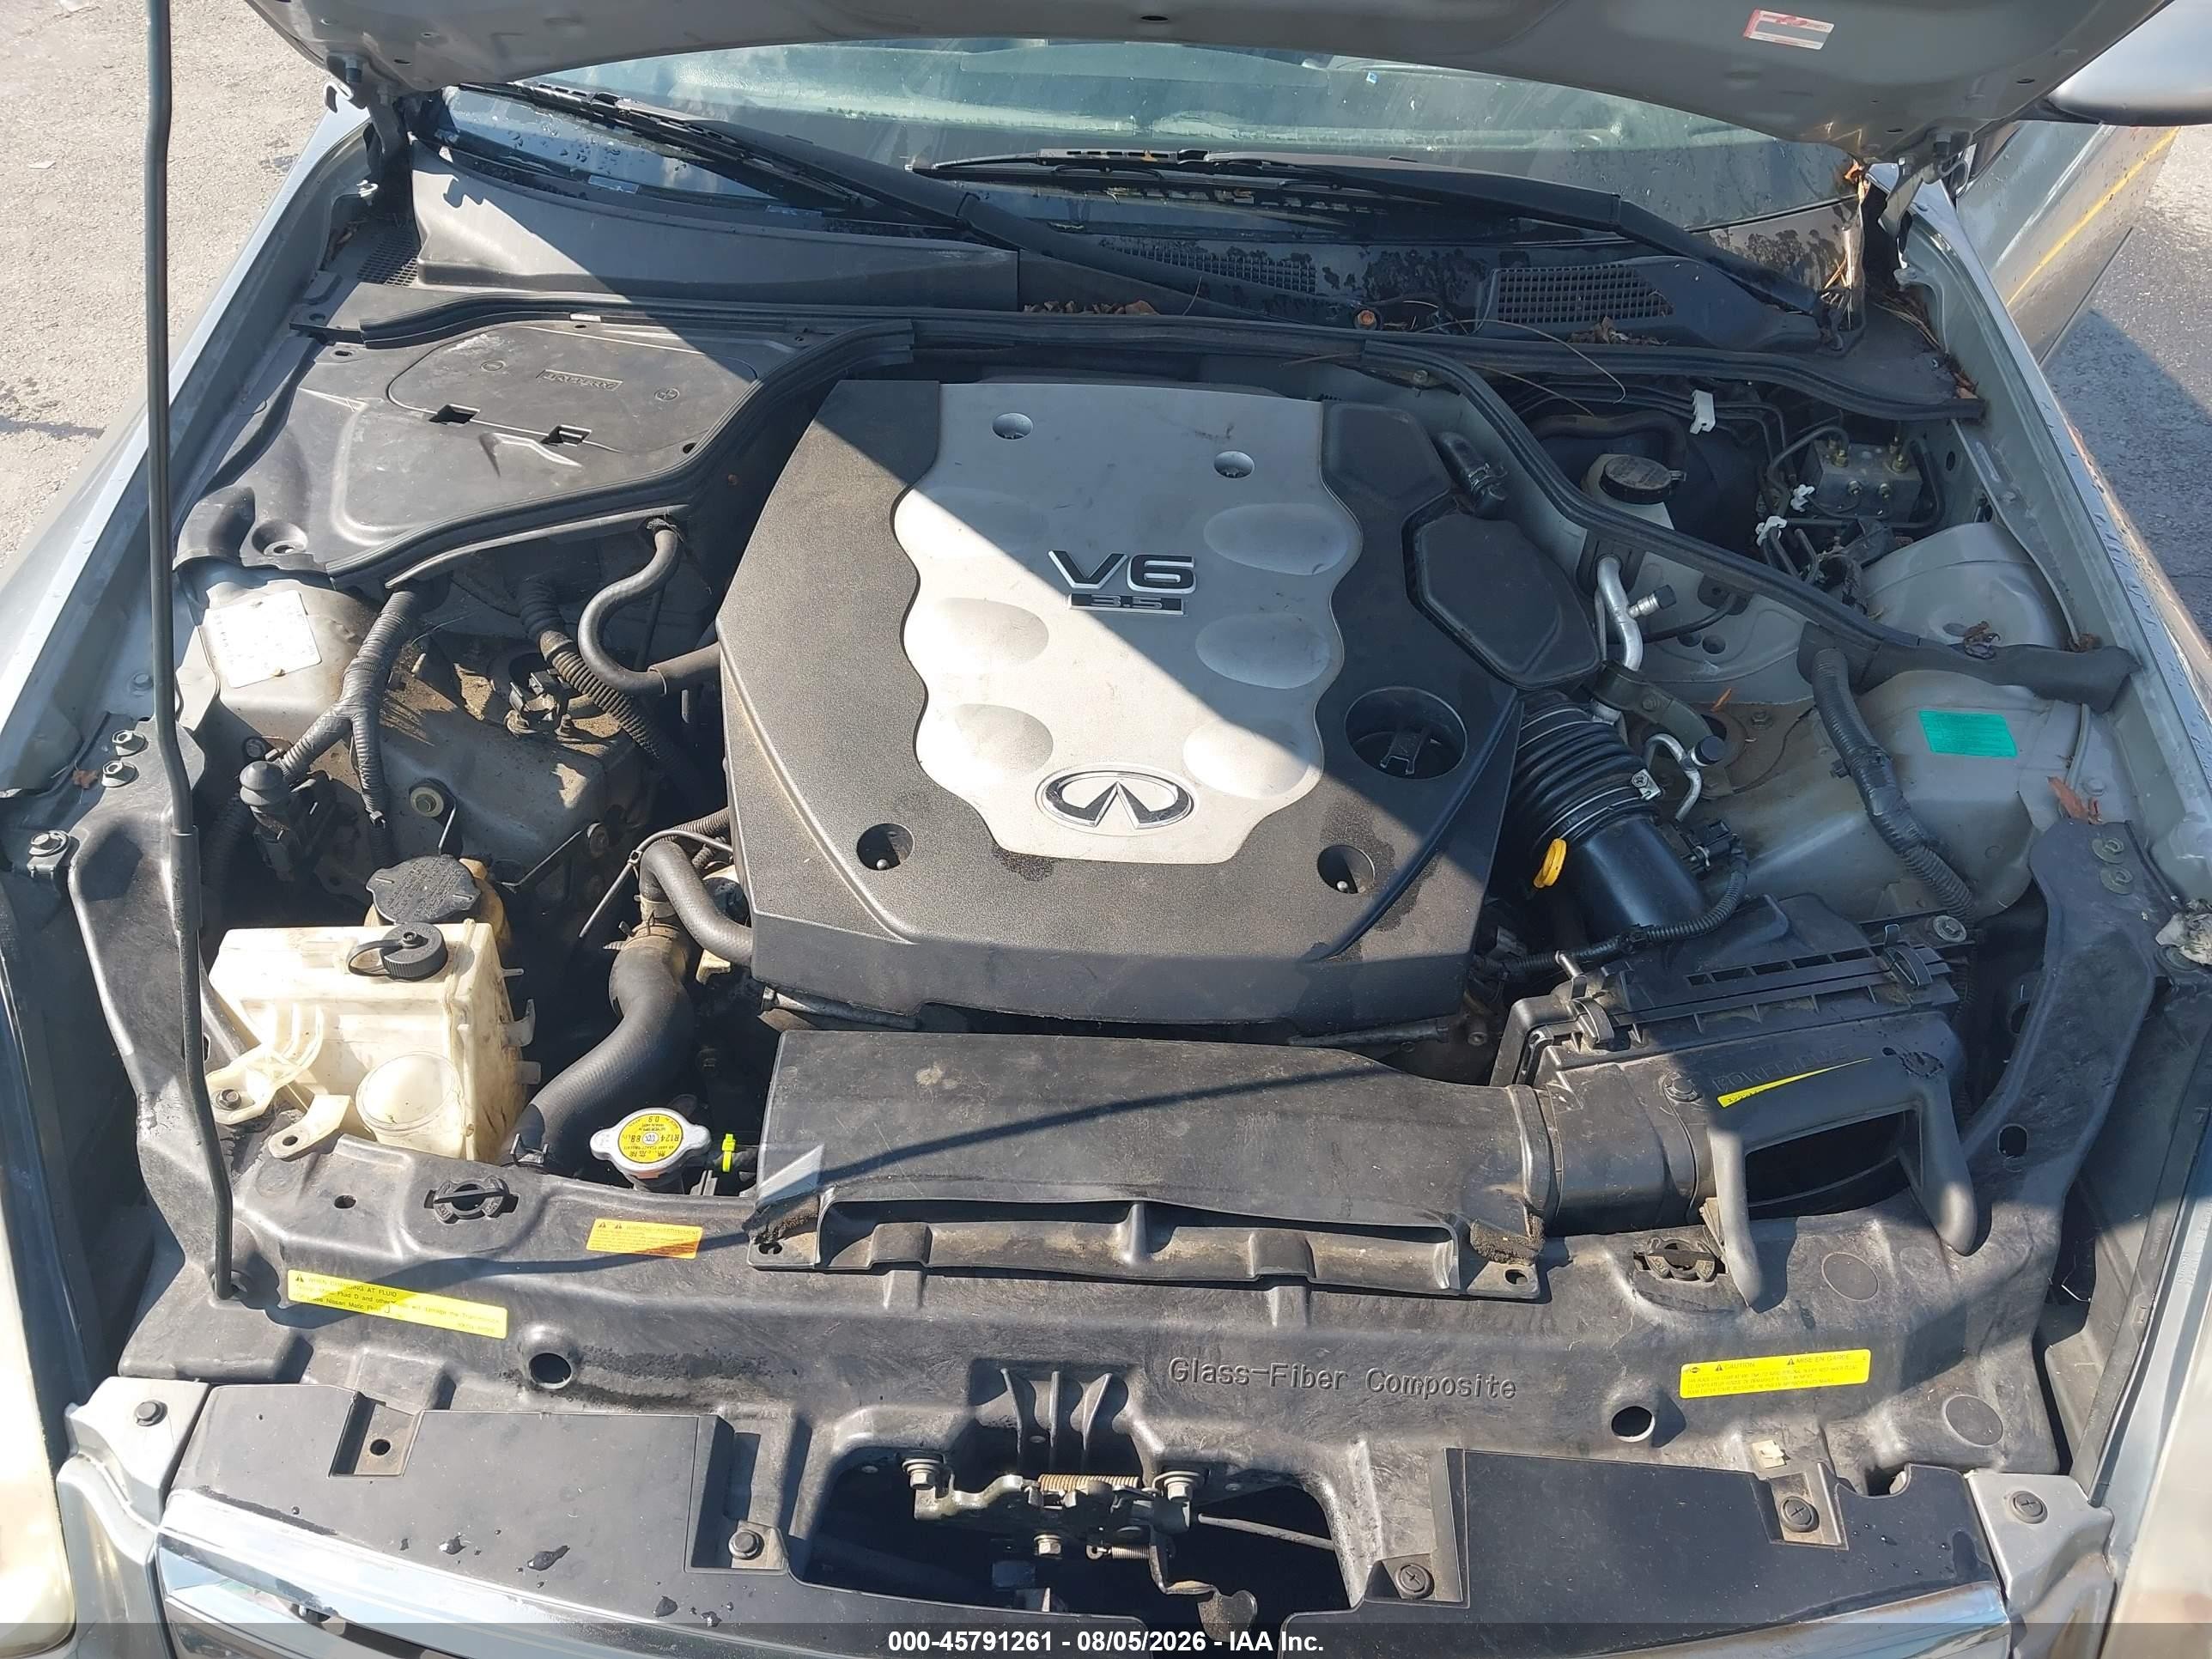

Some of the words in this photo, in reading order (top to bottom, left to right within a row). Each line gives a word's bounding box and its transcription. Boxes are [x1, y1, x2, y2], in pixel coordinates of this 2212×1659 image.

[1048, 550, 1196, 594] V6
[1091, 594, 1163, 610] 3.5
[325, 1297, 346, 1306] Nissan
[1168, 1357, 1348, 1390] Glass-Fiber
[1365, 1367, 1517, 1401] Composite
